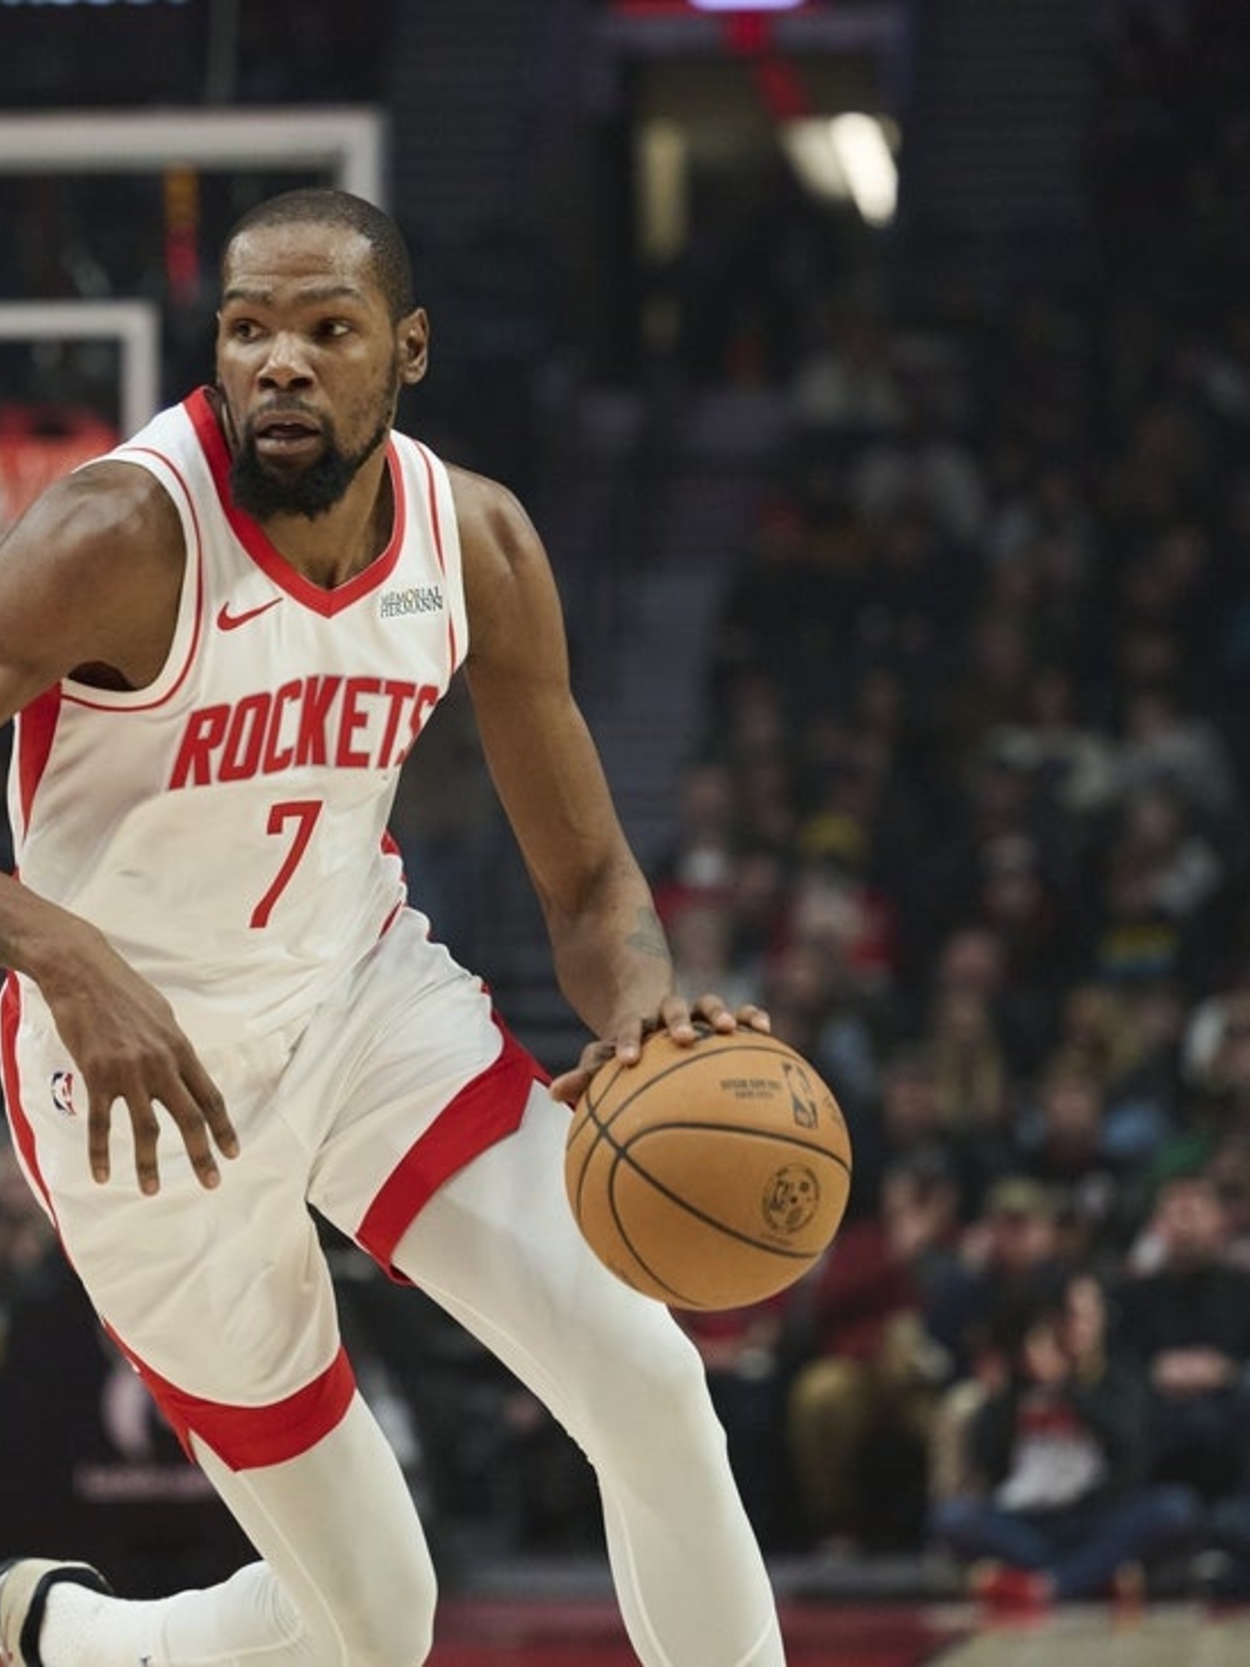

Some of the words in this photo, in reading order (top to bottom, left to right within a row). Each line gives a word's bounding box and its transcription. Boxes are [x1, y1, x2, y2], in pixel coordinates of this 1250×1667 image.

[381, 586, 441, 604] MEMORIAL
[381, 595, 443, 617] HERMANN
[249, 800, 323, 929] 7
